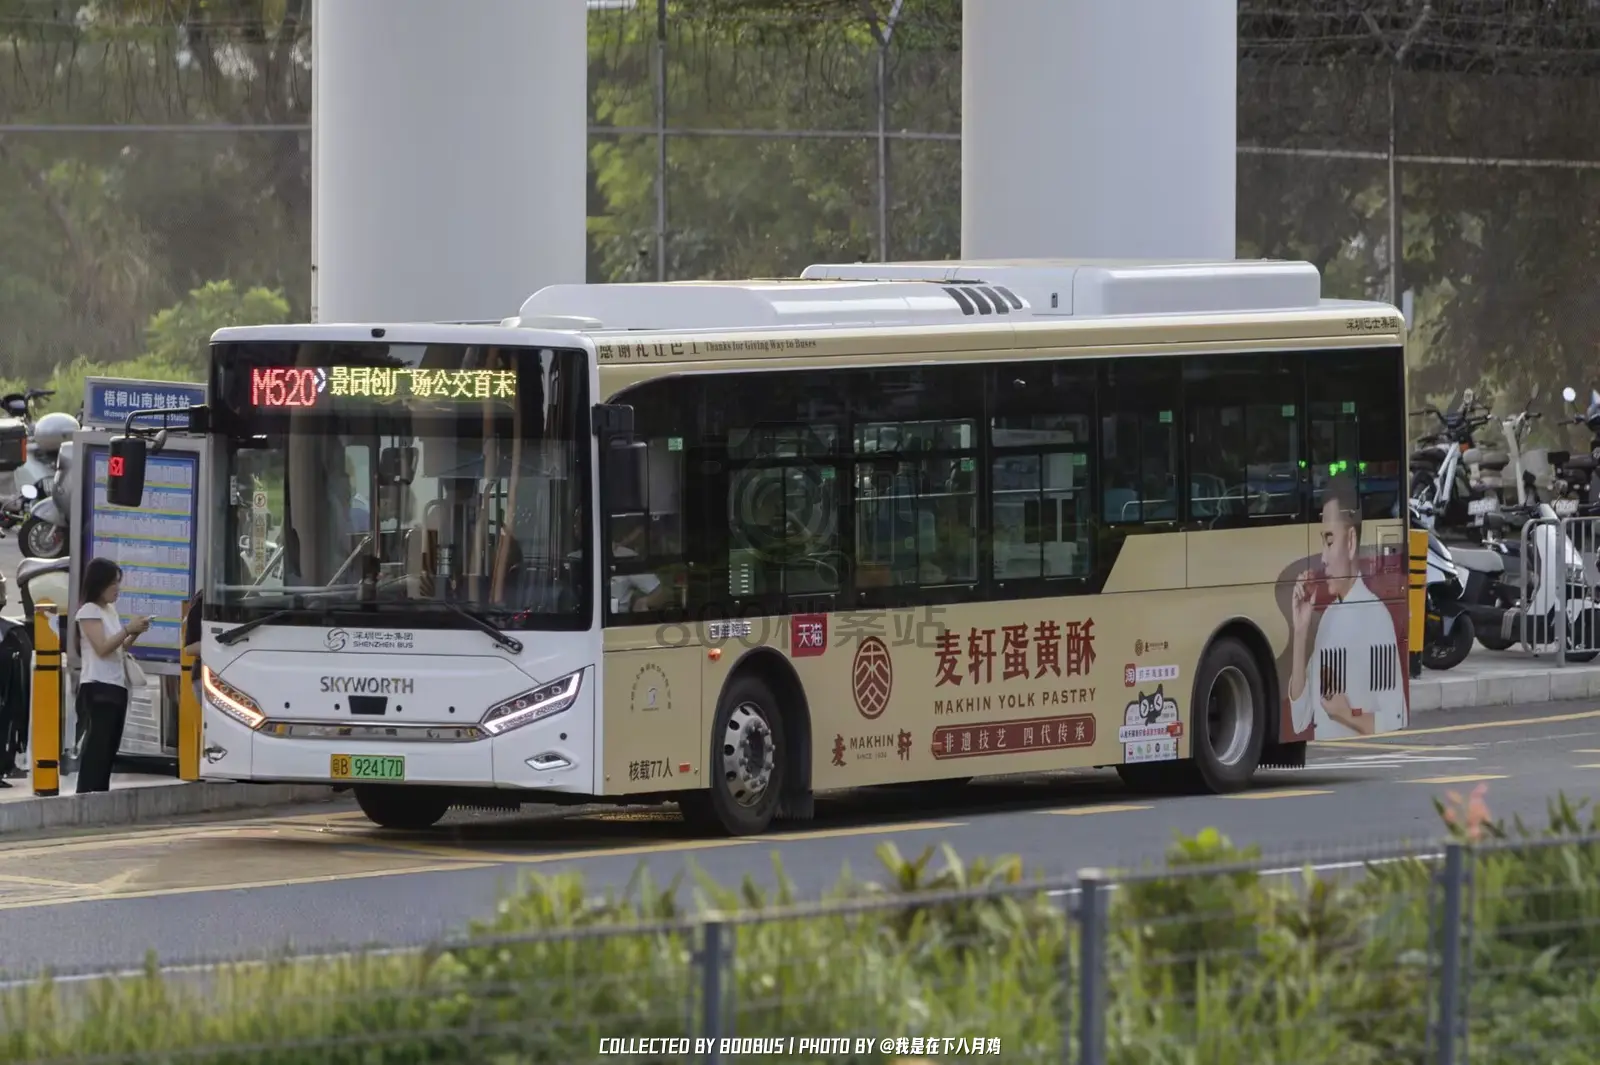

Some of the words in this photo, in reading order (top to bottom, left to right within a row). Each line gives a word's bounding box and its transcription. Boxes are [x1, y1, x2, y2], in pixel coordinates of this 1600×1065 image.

[705, 342, 732, 352] Thanks
[732, 341, 743, 351] for
[745, 341, 769, 352] Giving
[770, 340, 785, 352] Way
[786, 340, 794, 349] to
[795, 339, 817, 349] Buses
[252, 368, 317, 406] M520
[329, 366, 516, 398] 景同创广场公交首末
[103, 389, 191, 409] 梧桐山南地铁站
[353, 632, 414, 641] 深圳巴士集团
[798, 623, 823, 647] 天猫
[935, 617, 1096, 687] 麦轩蛋黄酥
[320, 676, 414, 694] SKYWORTH
[934, 697, 992, 714] MAKHIN
[998, 693, 1035, 708] YOLK
[1043, 688, 1096, 705] PASTRY
[850, 734, 894, 750] MAKHIN
[944, 728, 1007, 753] 非遗技艺
[1023, 722, 1085, 746] 四代传承
[355, 758, 403, 777] 92417D
[629, 757, 673, 781] 核载77人
